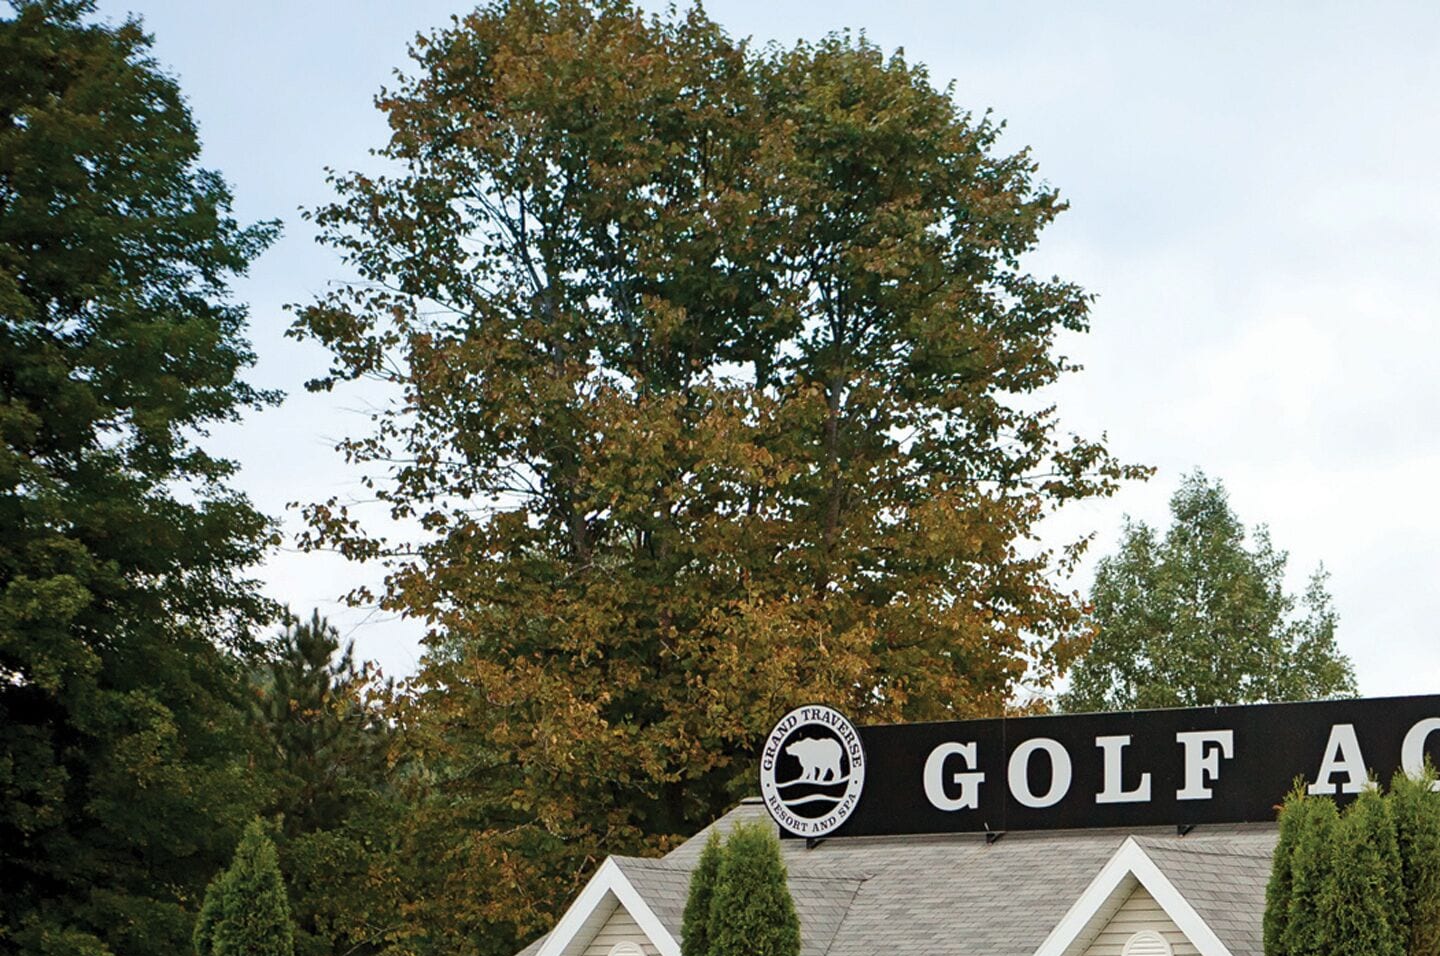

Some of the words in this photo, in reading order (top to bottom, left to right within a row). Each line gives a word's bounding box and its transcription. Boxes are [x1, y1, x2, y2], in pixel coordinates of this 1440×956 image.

[763, 715, 798, 771] GRAND
[801, 708, 862, 768] TRAVERSE
[922, 729, 1234, 811] GOLF
[769, 795, 808, 832] RESORT
[812, 816, 837, 833] AND
[838, 793, 856, 818] SPA
